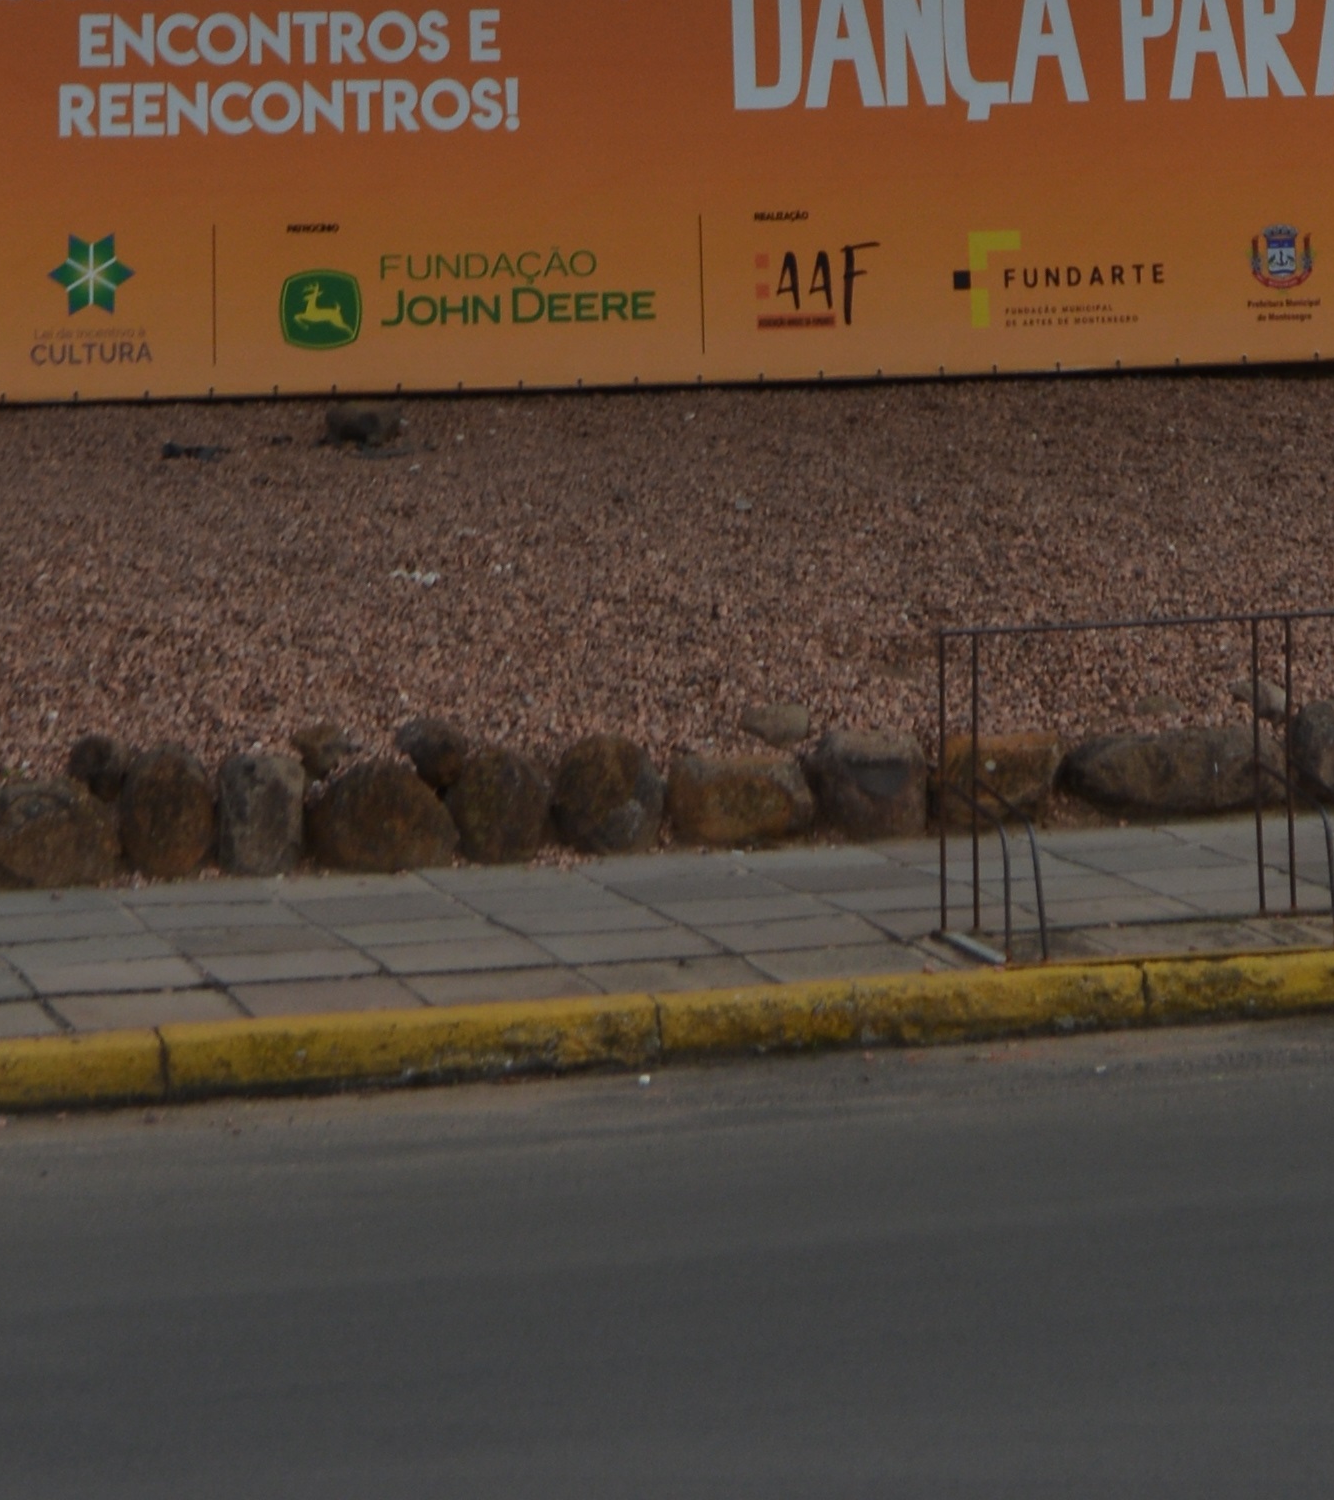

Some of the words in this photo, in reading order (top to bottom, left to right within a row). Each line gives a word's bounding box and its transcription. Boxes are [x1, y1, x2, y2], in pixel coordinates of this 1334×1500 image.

[79, 10, 449, 68] ENCONTROS
[469, 9, 500, 62] E
[58, 77, 519, 139] REENCONTROS!
[753, 210, 809, 223] REALIZAÇÃO
[379, 247, 598, 284] FUNDAÇÃO
[777, 241, 880, 326] AAF
[1003, 263, 1165, 289] FUNDARTE
[381, 289, 502, 327] JOHN
[511, 286, 656, 324] DEERE
[29, 341, 153, 367] CULTURA
